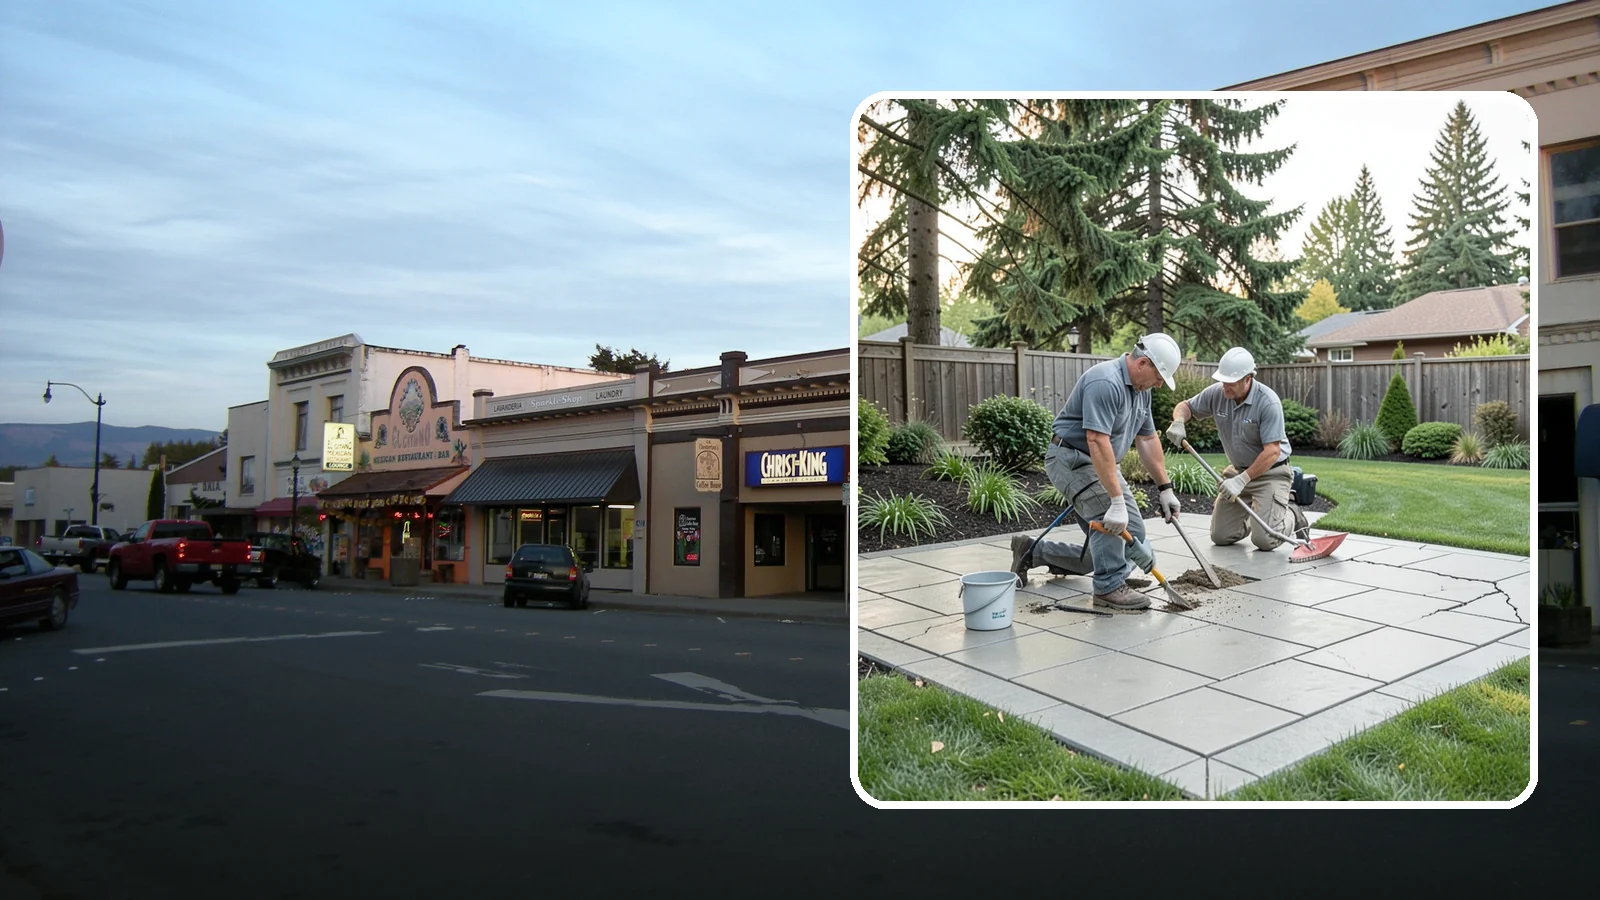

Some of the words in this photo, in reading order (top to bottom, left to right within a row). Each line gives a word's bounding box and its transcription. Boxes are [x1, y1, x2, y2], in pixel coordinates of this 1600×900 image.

[596, 389, 623, 400] LAUNDRY
[494, 402, 522, 413] LAVANDERIA
[531, 397, 560, 410] Sparkle
[562, 394, 583, 406] Shop
[373, 454, 396, 464] MEXICAN
[397, 451, 433, 463] RESTAURANT
[438, 450, 450, 459] BAR
[761, 452, 797, 478] CHRIST
[799, 450, 827, 477] KING
[696, 480, 709, 489] Coffee
[710, 480, 722, 489] House
